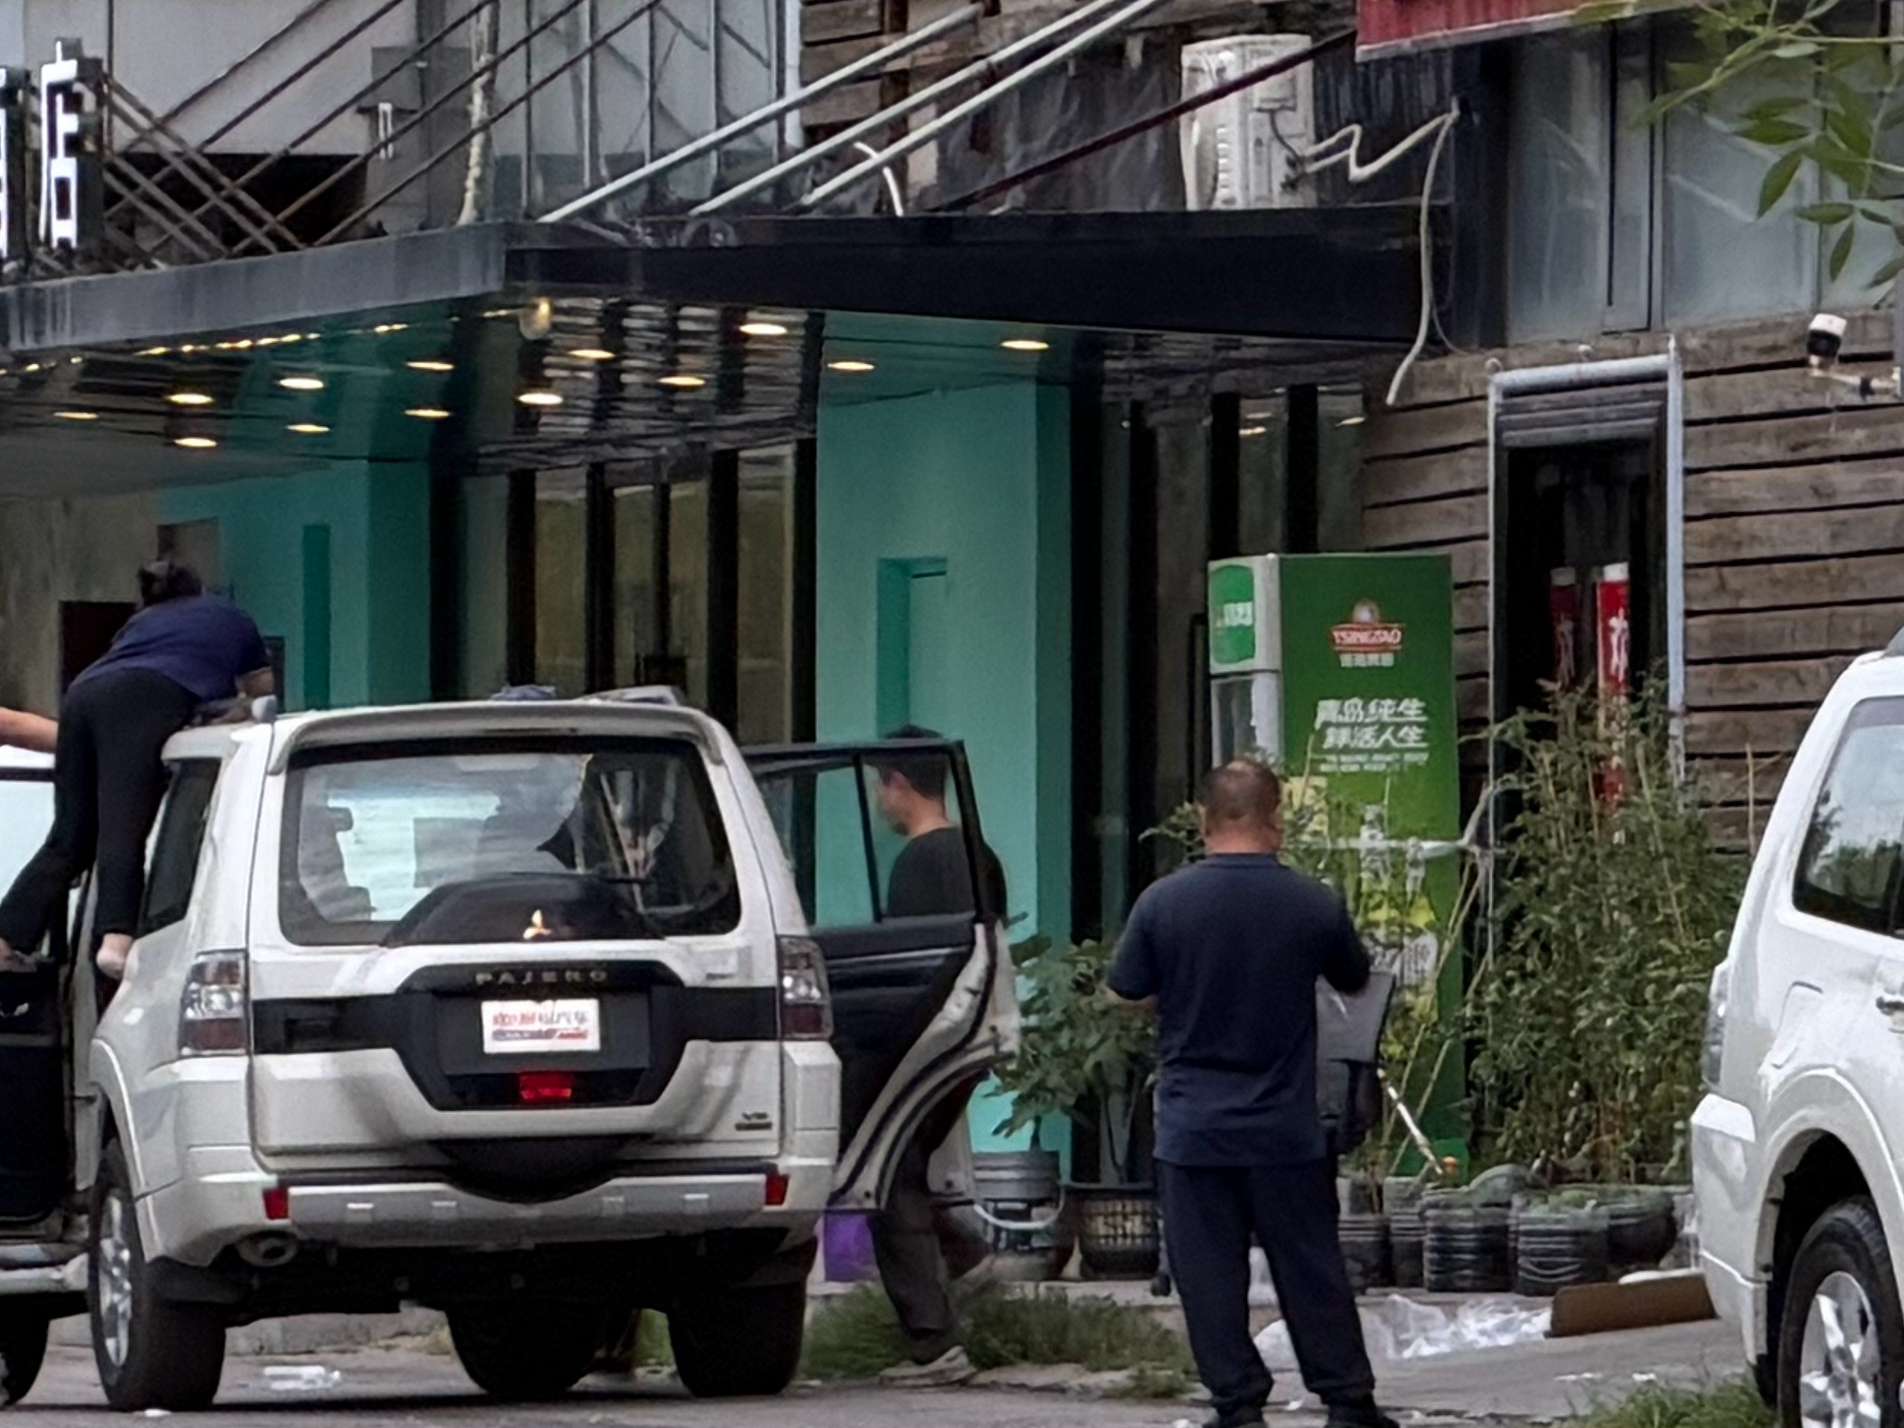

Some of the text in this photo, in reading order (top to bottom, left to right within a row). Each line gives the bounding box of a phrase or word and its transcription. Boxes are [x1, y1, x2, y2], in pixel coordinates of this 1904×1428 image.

[1314, 696, 1429, 729] 青岛纯生
[1322, 725, 1429, 750] 鲜活人生
[474, 969, 609, 986] PAJERO
